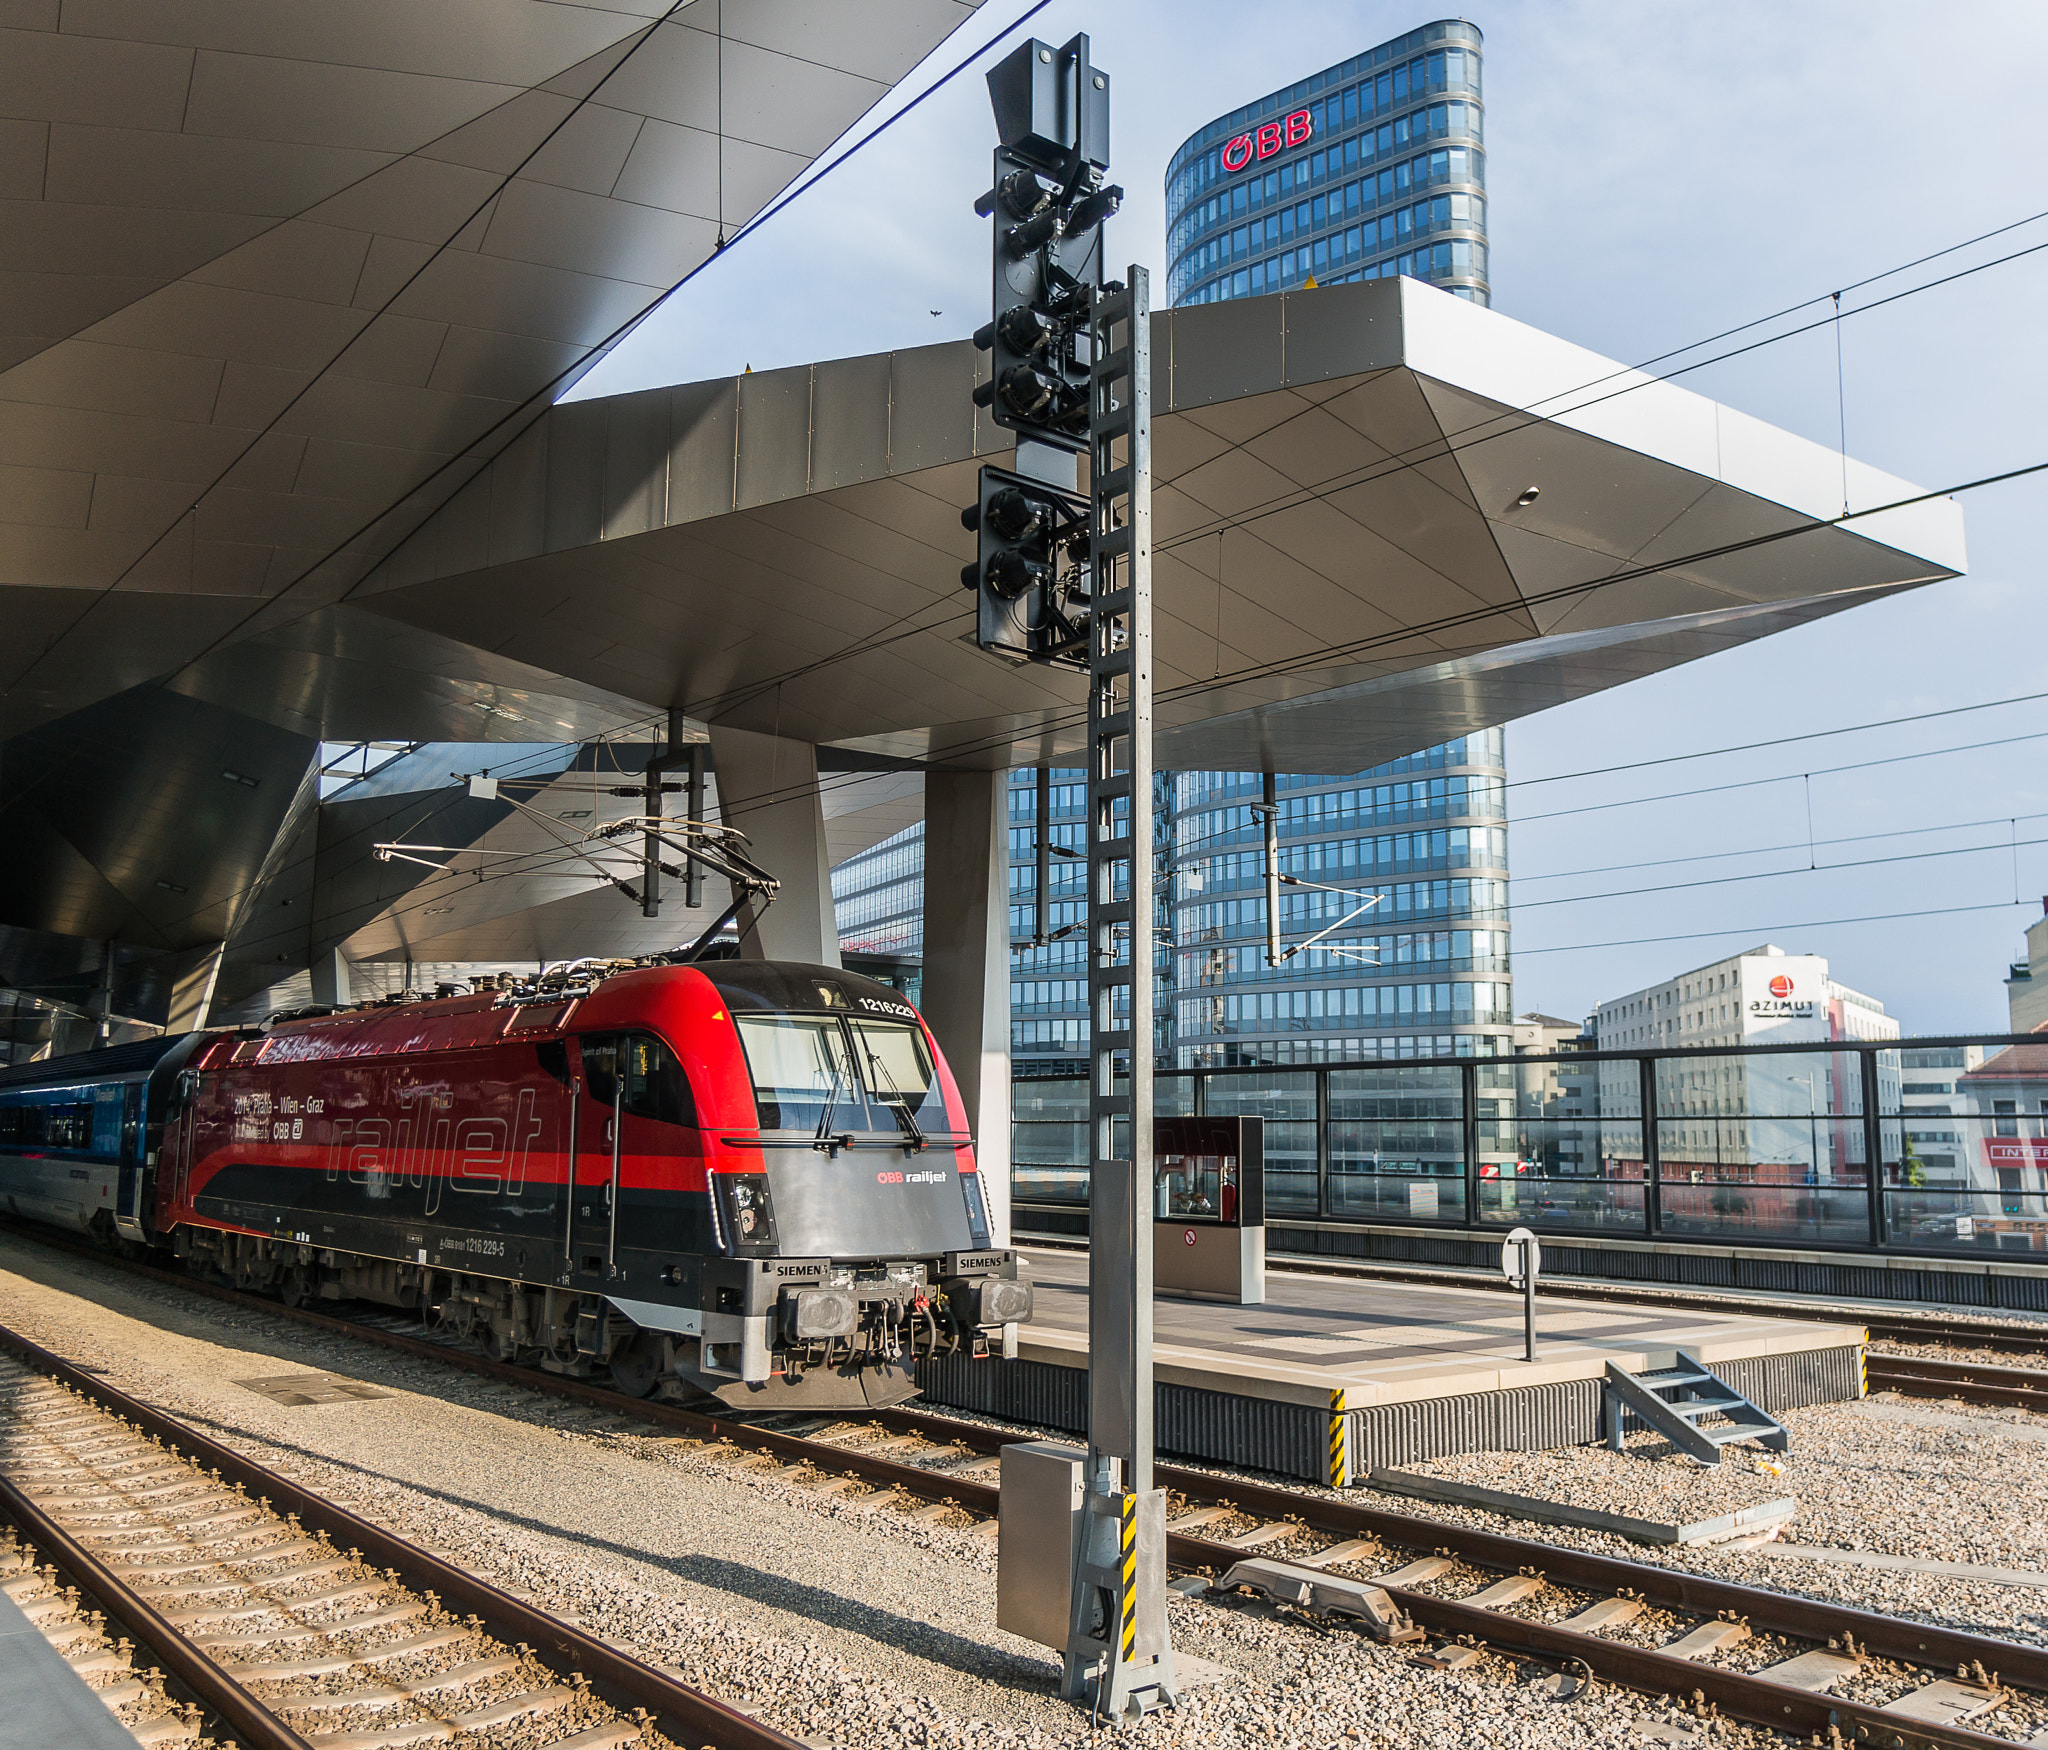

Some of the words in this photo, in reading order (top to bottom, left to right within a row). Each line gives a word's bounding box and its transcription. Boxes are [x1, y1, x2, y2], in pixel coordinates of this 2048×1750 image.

[1222, 109, 1312, 172] ÖBB
[858, 997, 916, 1019] 1216229
[280, 1095, 298, 1114] Wien
[306, 1095, 324, 1114] Graz
[273, 1121, 290, 1140] ÖBB
[327, 1088, 542, 1216] railjet
[876, 1171, 904, 1185] ÖBB
[905, 1170, 947, 1185] railjet
[483, 1240, 505, 1257] 229-5
[776, 1264, 828, 1277] SIEMENS
[960, 1256, 1002, 1269] SIEMENS
